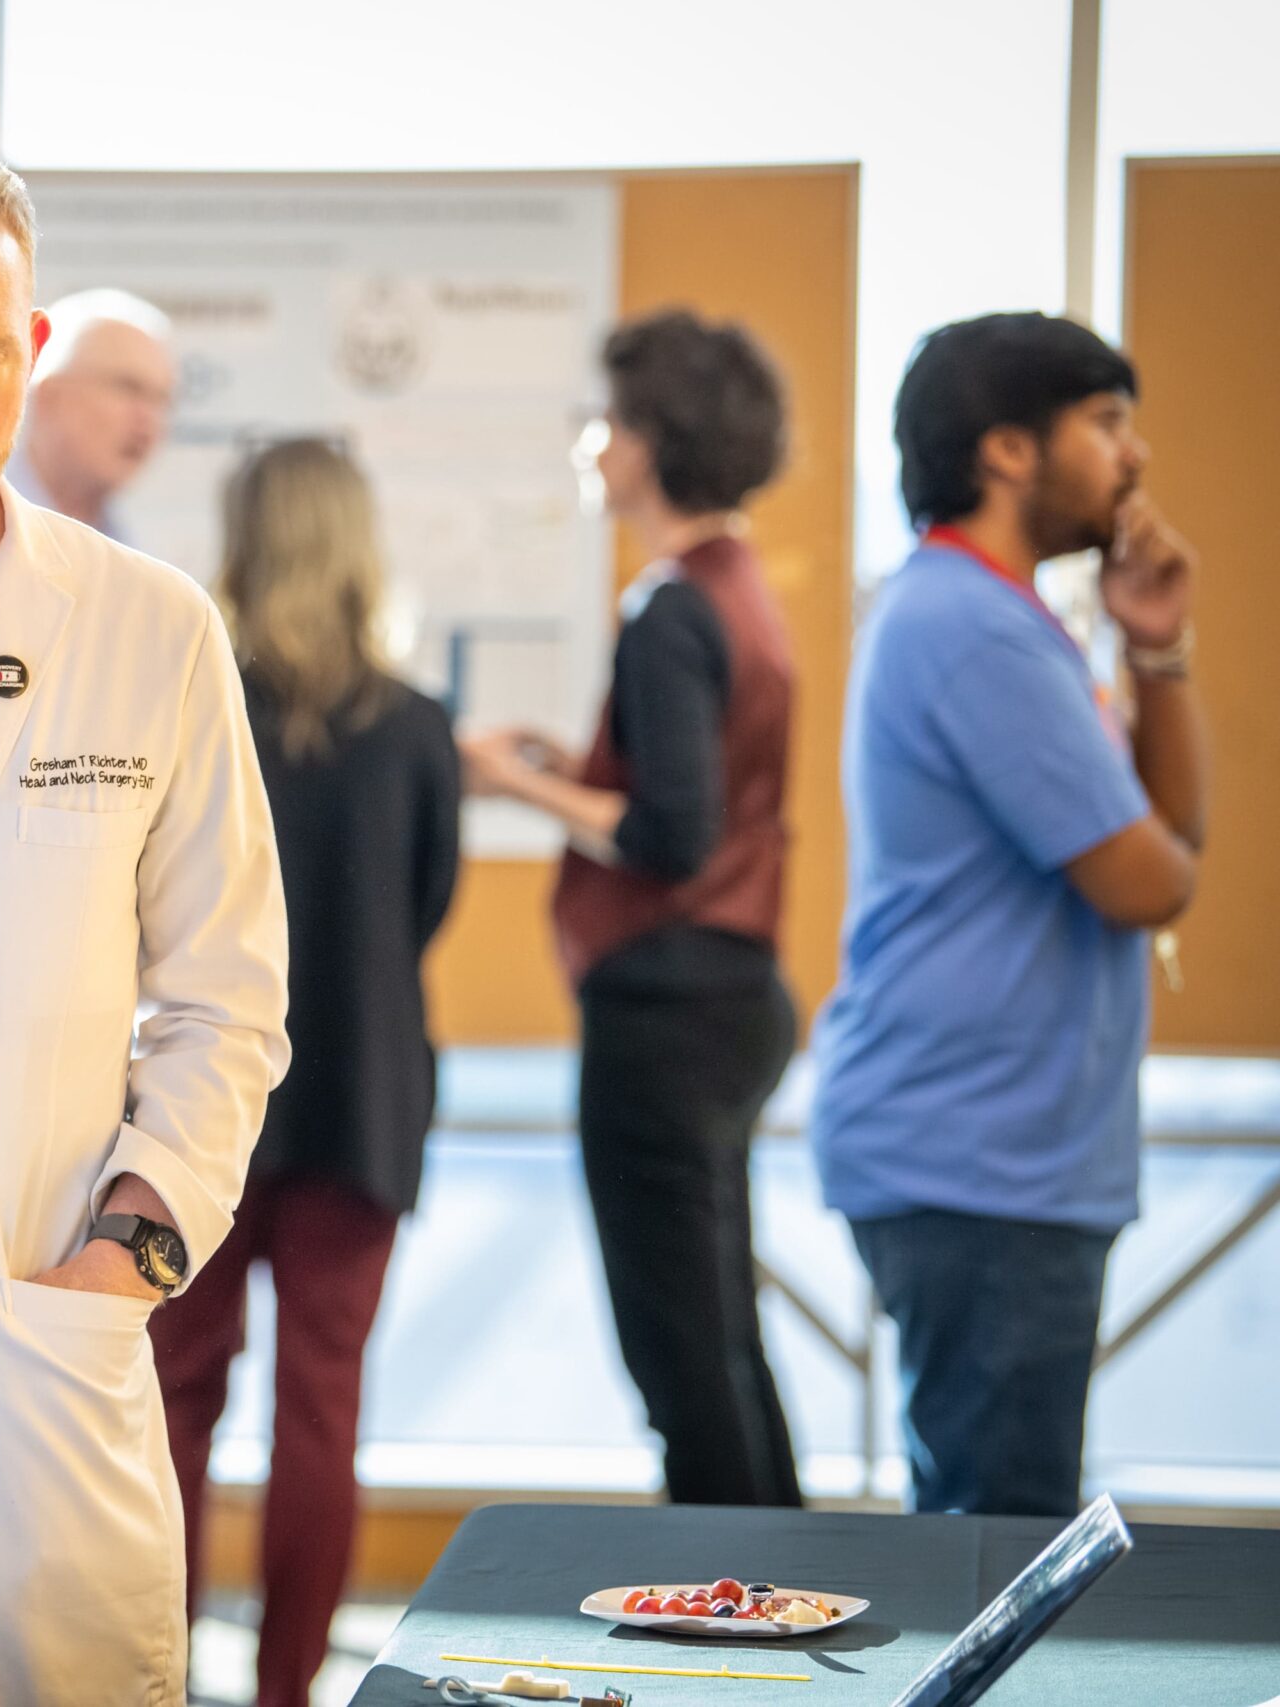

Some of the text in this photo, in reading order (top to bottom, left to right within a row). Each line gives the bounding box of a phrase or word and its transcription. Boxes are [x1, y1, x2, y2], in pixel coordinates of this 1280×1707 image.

[30, 754, 148, 772] Gresham T Richter, MD
[19, 774, 47, 789] Head
[49, 772, 69, 787] and
[70, 770, 97, 785] Neck
